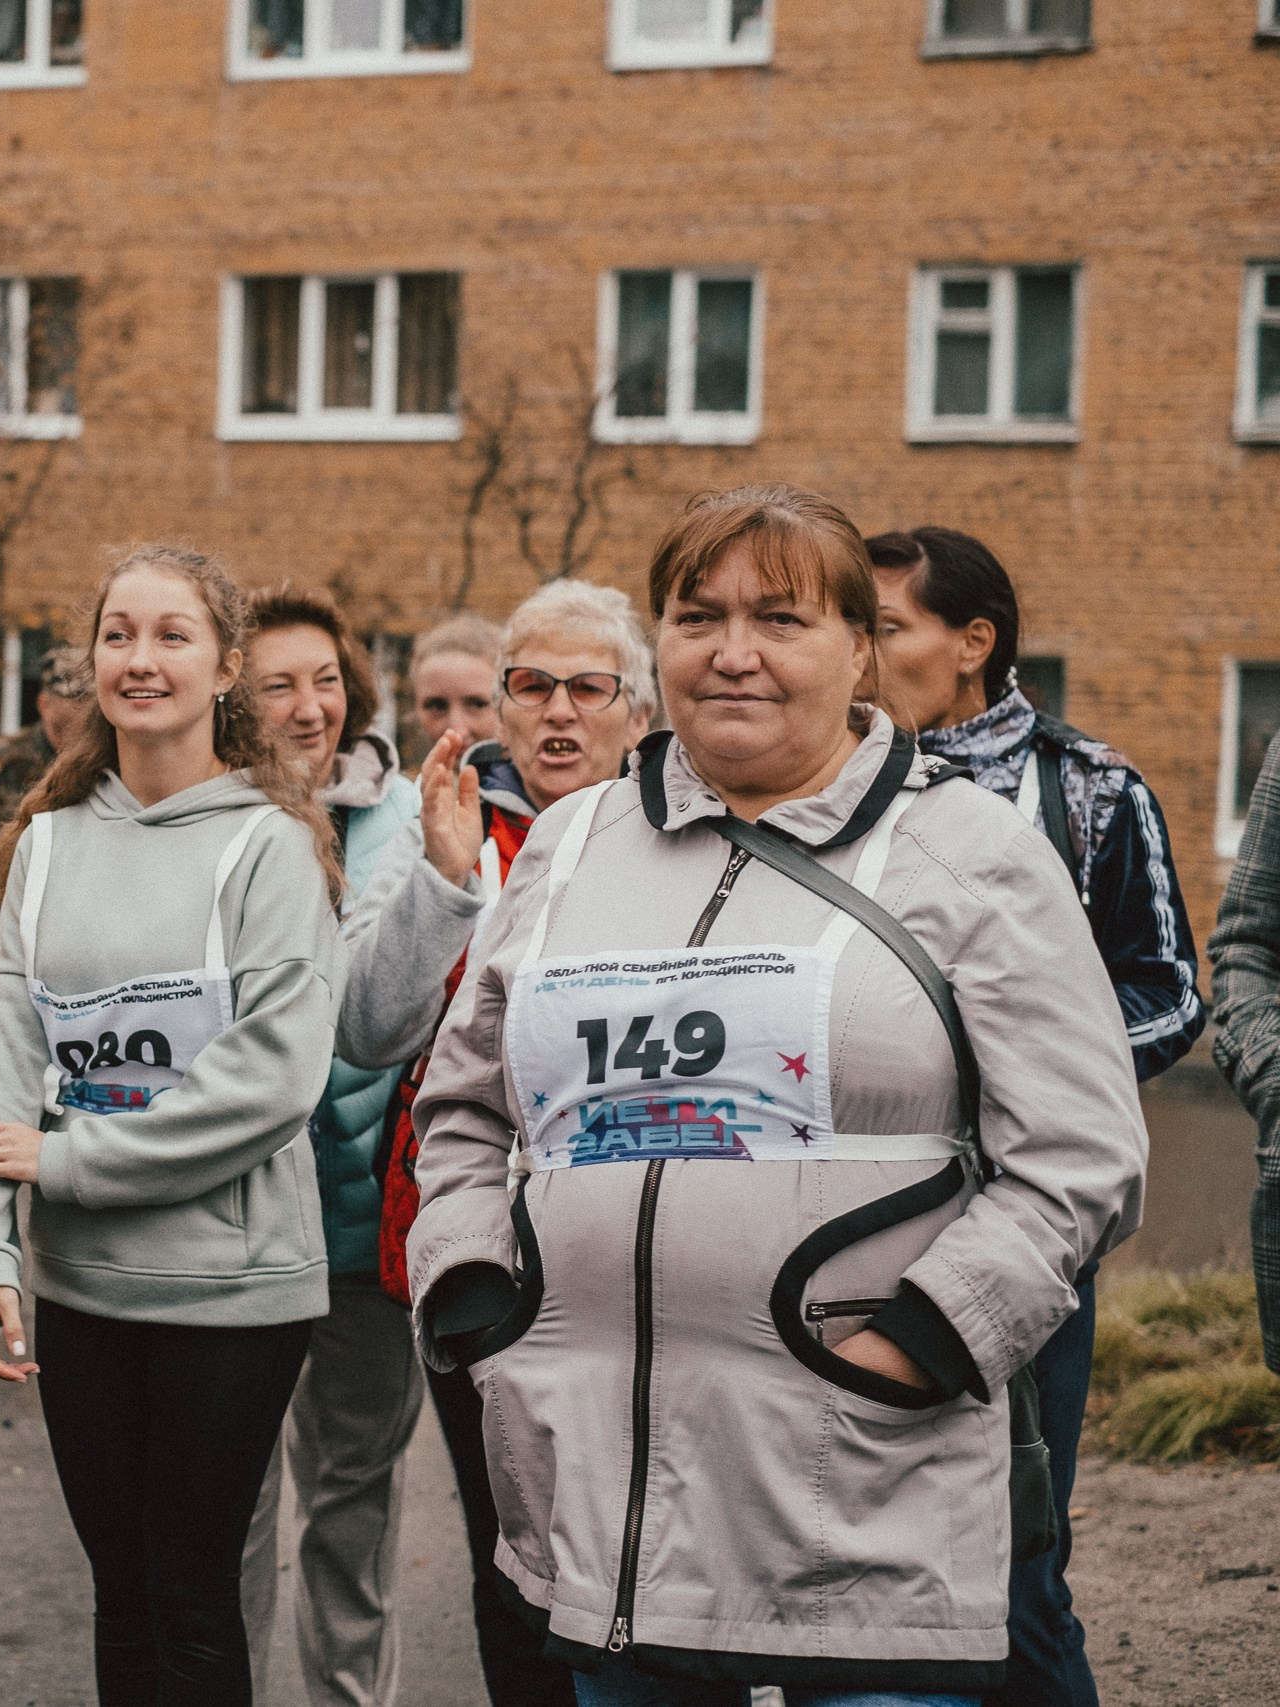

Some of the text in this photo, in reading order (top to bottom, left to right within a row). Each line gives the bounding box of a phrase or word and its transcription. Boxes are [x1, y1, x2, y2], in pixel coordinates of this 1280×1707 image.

[535, 977, 585, 992] ЙЕТИ
[587, 976, 650, 987] ДЕНЬ
[681, 963, 794, 979] КИЛЬДИНСТРОЙ
[545, 952, 785, 978] ОБЛАСТНОЙ СЕМЕЙНЫЙ ФЕСТИВАЛЬ
[121, 987, 202, 1004] КИЛЬДИНСТРОЙ
[131, 978, 193, 991] ФЕСТИВАЛЬ
[576, 1010, 726, 1085] 149
[578, 1094, 738, 1128] ЙЕТИ
[568, 1123, 762, 1154] ЗАБЕГ
